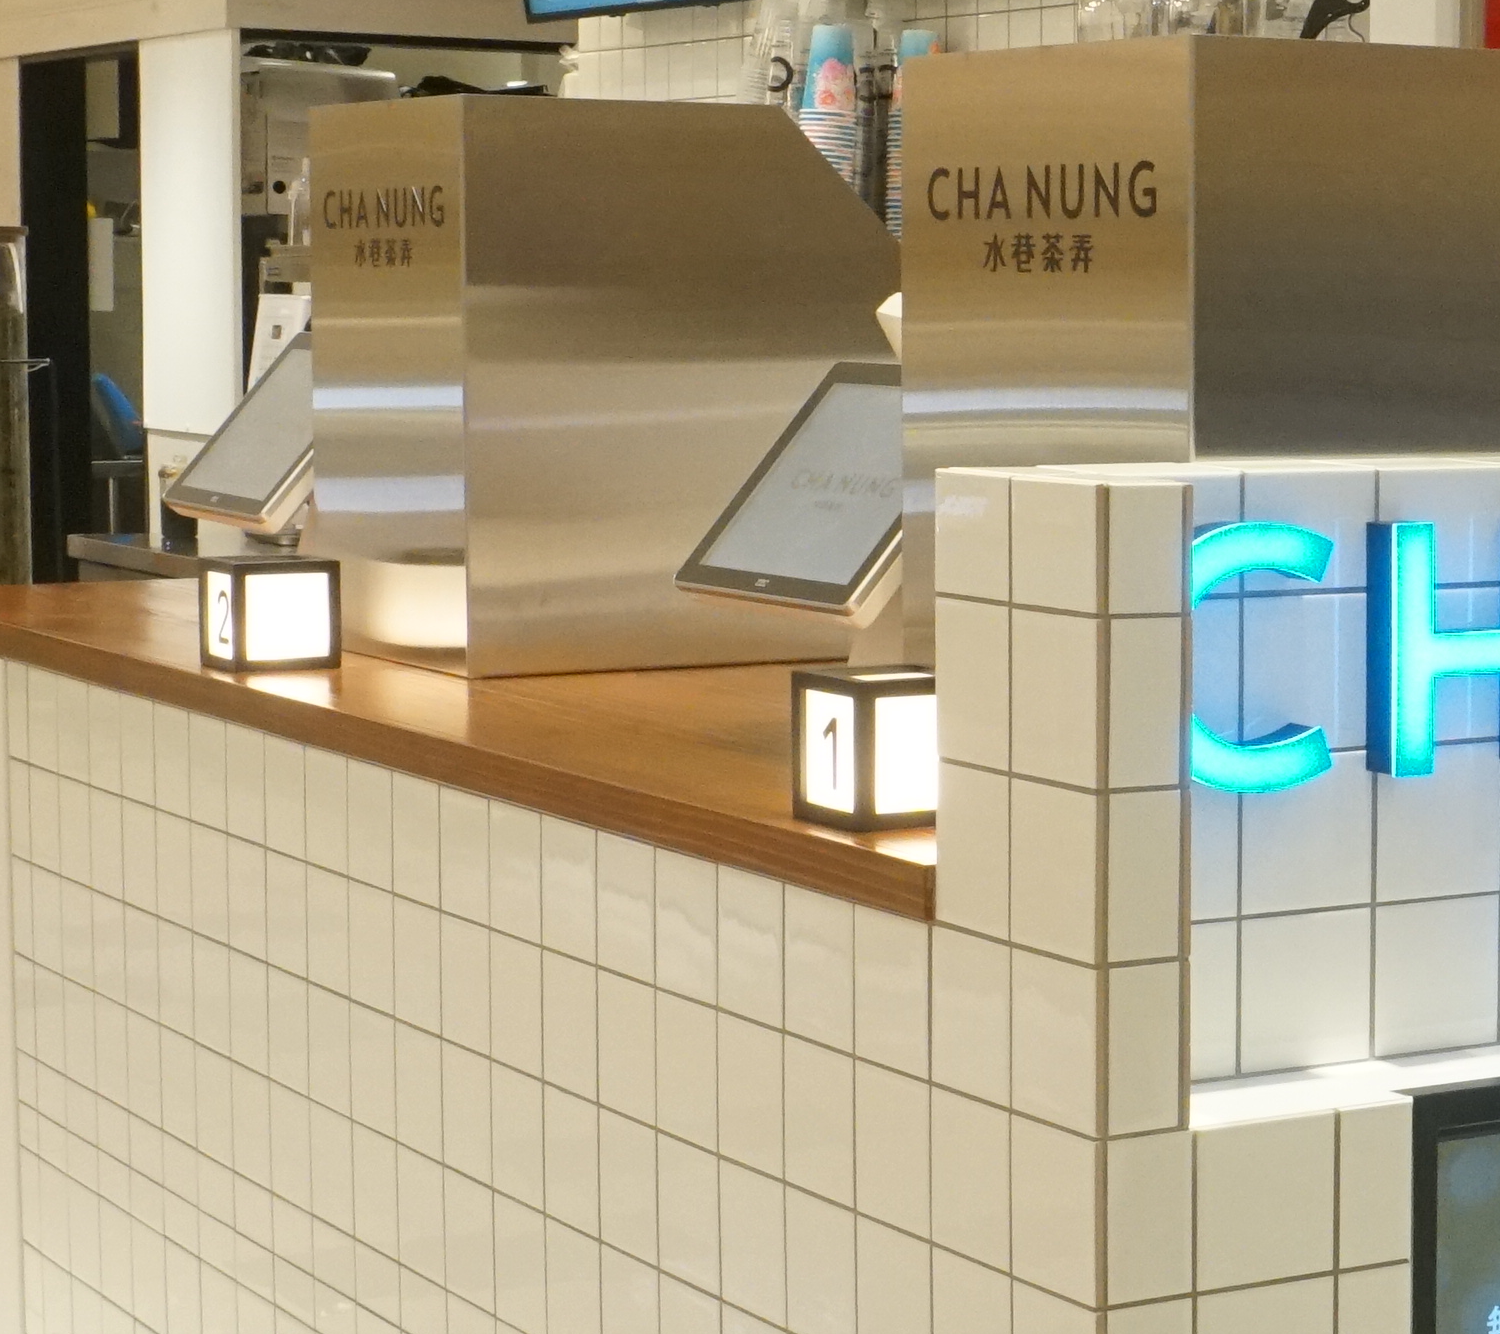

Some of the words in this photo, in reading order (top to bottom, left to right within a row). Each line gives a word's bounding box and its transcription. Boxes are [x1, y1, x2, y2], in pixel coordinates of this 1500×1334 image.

[323, 189, 369, 230] CHA
[376, 184, 445, 229] NUNG
[926, 163, 1013, 223] CHA
[1026, 159, 1159, 221] NUNG
[982, 233, 1095, 274] 水巷茶弄
[217, 589, 232, 646] 2
[821, 716, 840, 791] 1
